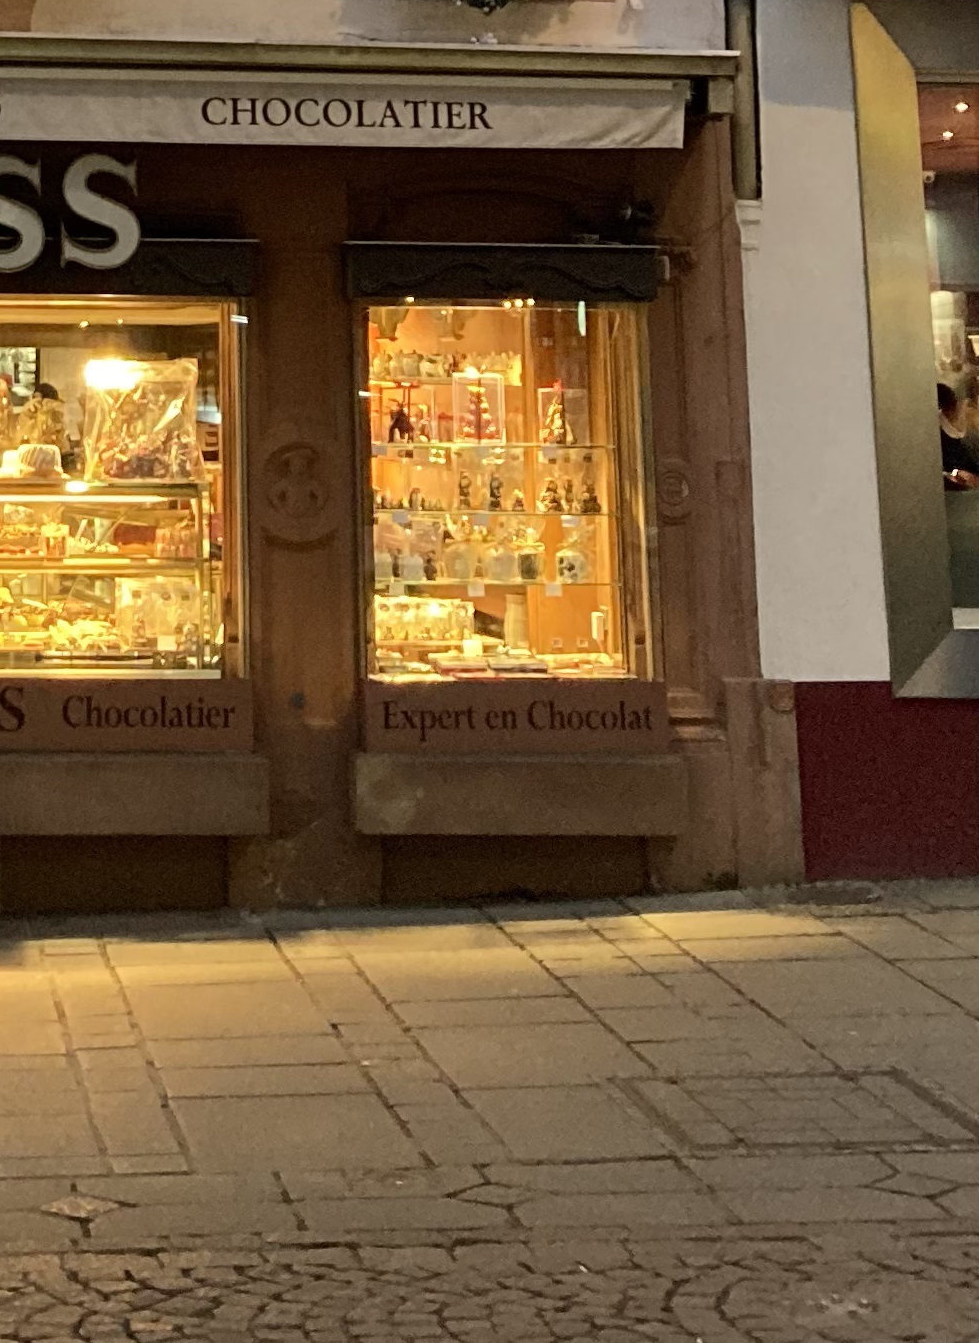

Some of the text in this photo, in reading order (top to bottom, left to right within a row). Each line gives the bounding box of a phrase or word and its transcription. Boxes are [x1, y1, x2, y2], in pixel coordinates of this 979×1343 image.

[201, 96, 494, 131] CHOCOLATIER
[61, 694, 237, 730] Chocolatier
[381, 698, 654, 744] Expert en Chocolat
